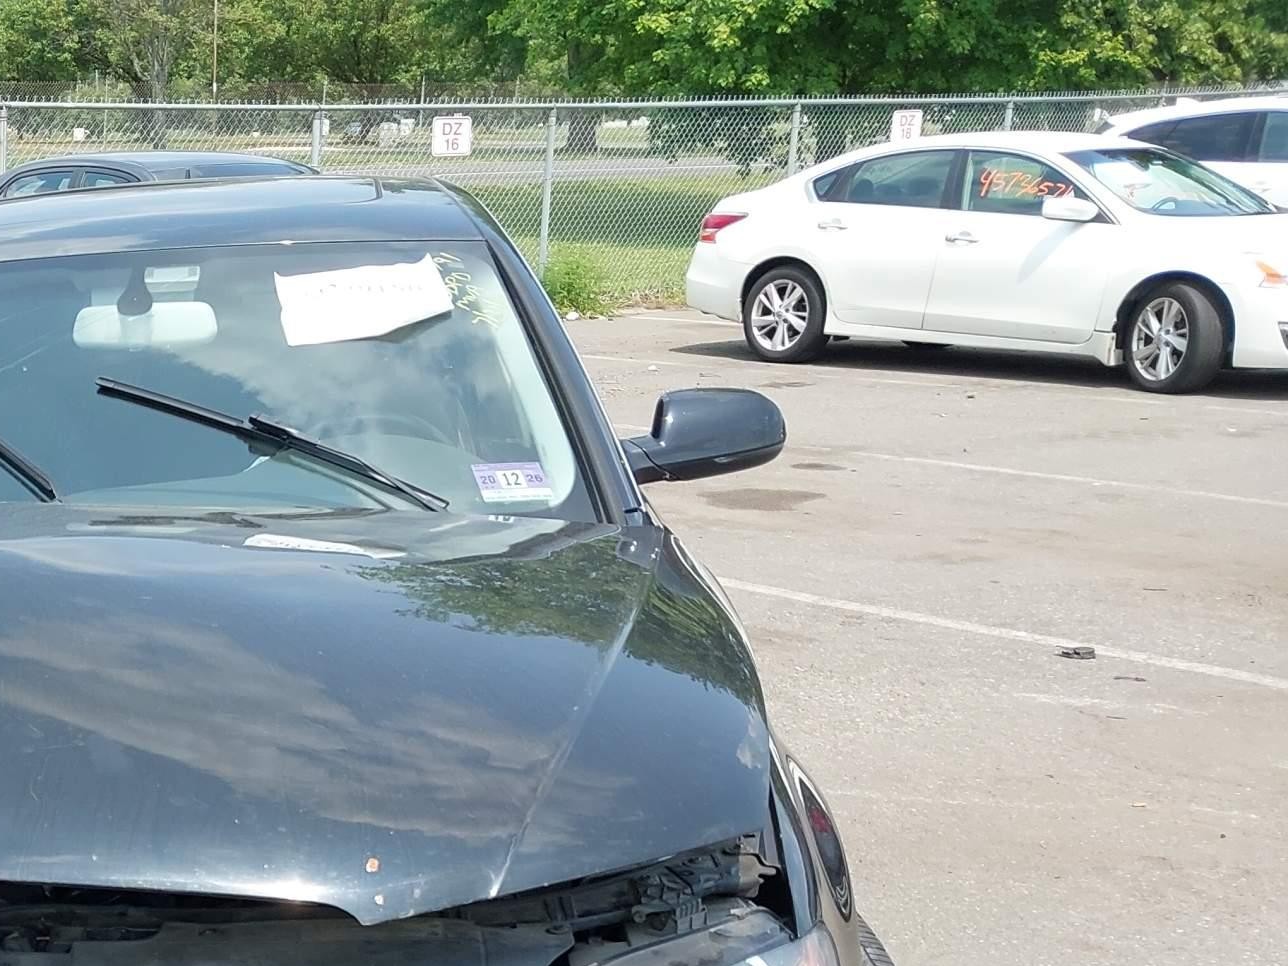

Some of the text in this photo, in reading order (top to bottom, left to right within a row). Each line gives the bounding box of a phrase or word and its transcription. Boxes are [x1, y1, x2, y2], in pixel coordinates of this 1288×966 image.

[899, 114, 916, 127] DZ
[442, 122, 463, 135] DZ
[445, 138, 459, 151] 16
[480, 475, 496, 485] 20
[501, 471, 522, 487] 12
